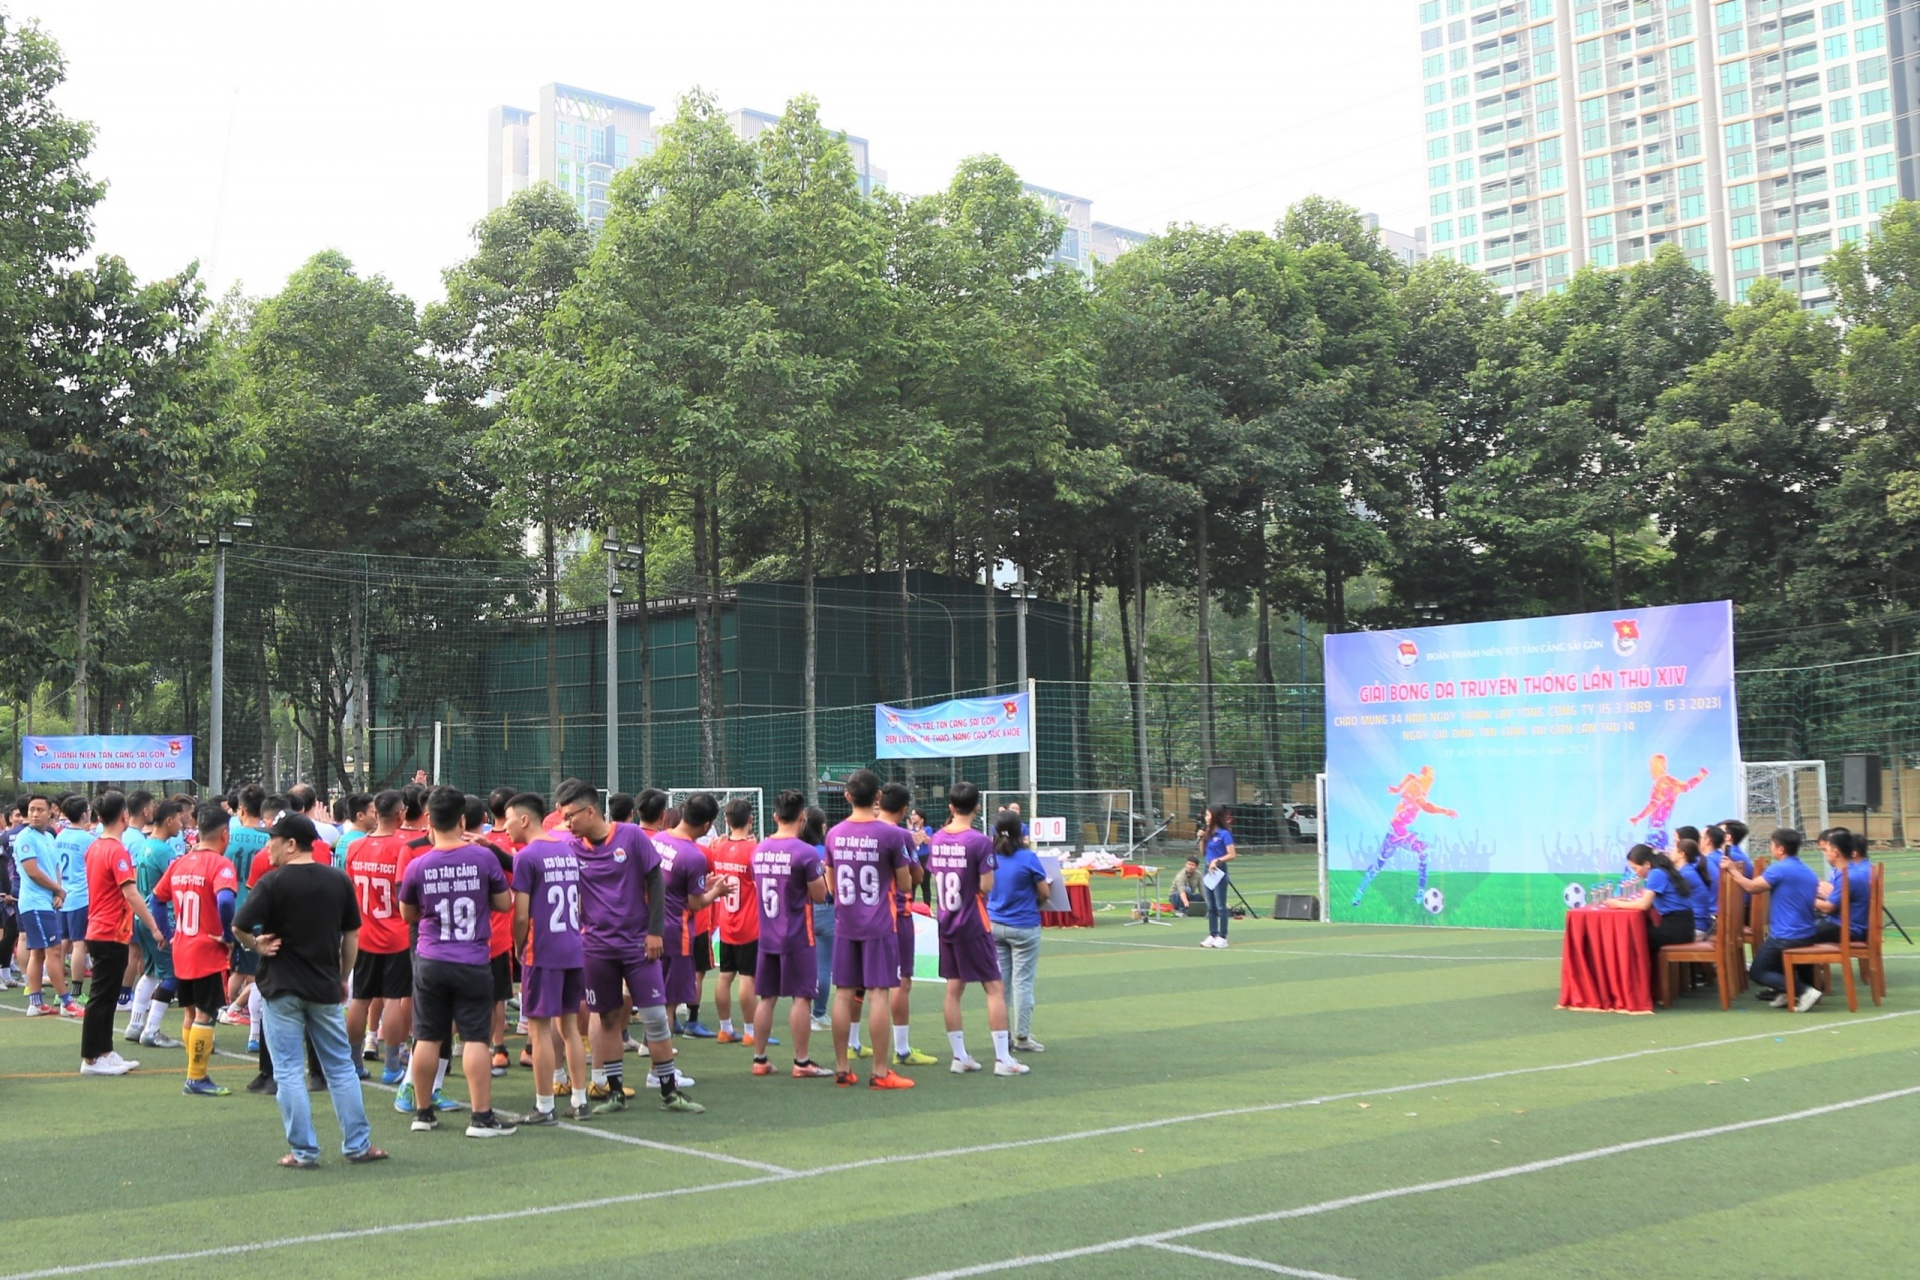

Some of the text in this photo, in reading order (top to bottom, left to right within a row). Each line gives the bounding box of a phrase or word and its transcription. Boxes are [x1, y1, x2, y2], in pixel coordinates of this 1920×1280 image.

[1656, 665, 1687, 688] XIV
[1391, 714, 1402, 724] 34
[60, 853, 70, 881] 2
[424, 862, 478, 881] ICD TÂN CẢNG
[837, 864, 880, 906] 69
[353, 874, 392, 919] 73
[761, 877, 780, 919] 5
[935, 870, 962, 912] 18
[434, 896, 477, 941] 19
